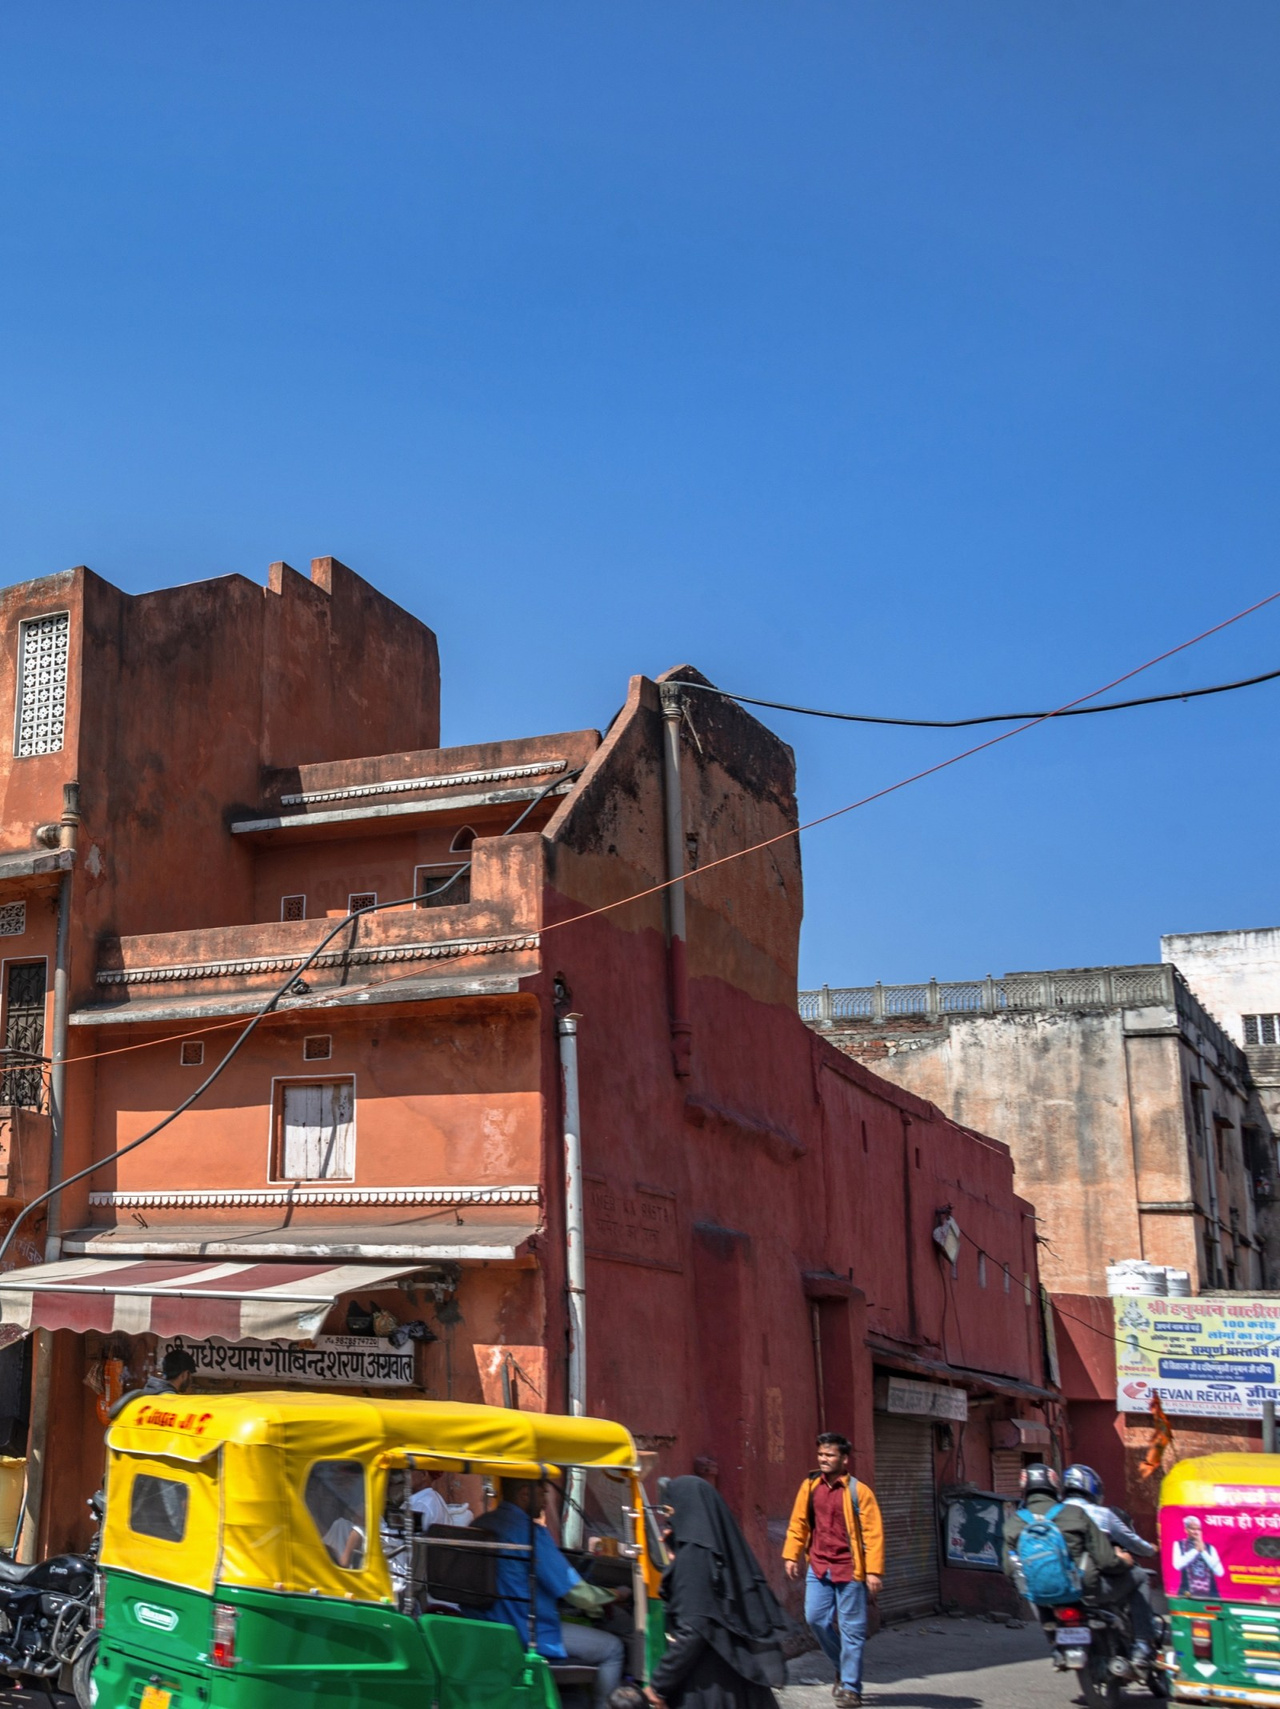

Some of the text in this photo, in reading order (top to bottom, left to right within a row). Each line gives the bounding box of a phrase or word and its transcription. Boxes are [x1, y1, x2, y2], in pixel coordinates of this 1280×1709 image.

[1147, 1300, 1280, 1319] श्री हनुमान चालीस
[1223, 1320, 1244, 1328] 100
[1255, 1331, 1280, 1341] संक
[366, 1353, 413, 1382] अग्रवाल
[1144, 1387, 1193, 1400] JEEVAN
[1196, 1390, 1242, 1403] REKHA
[1204, 1513, 1280, 1529] आज ही पंजी
